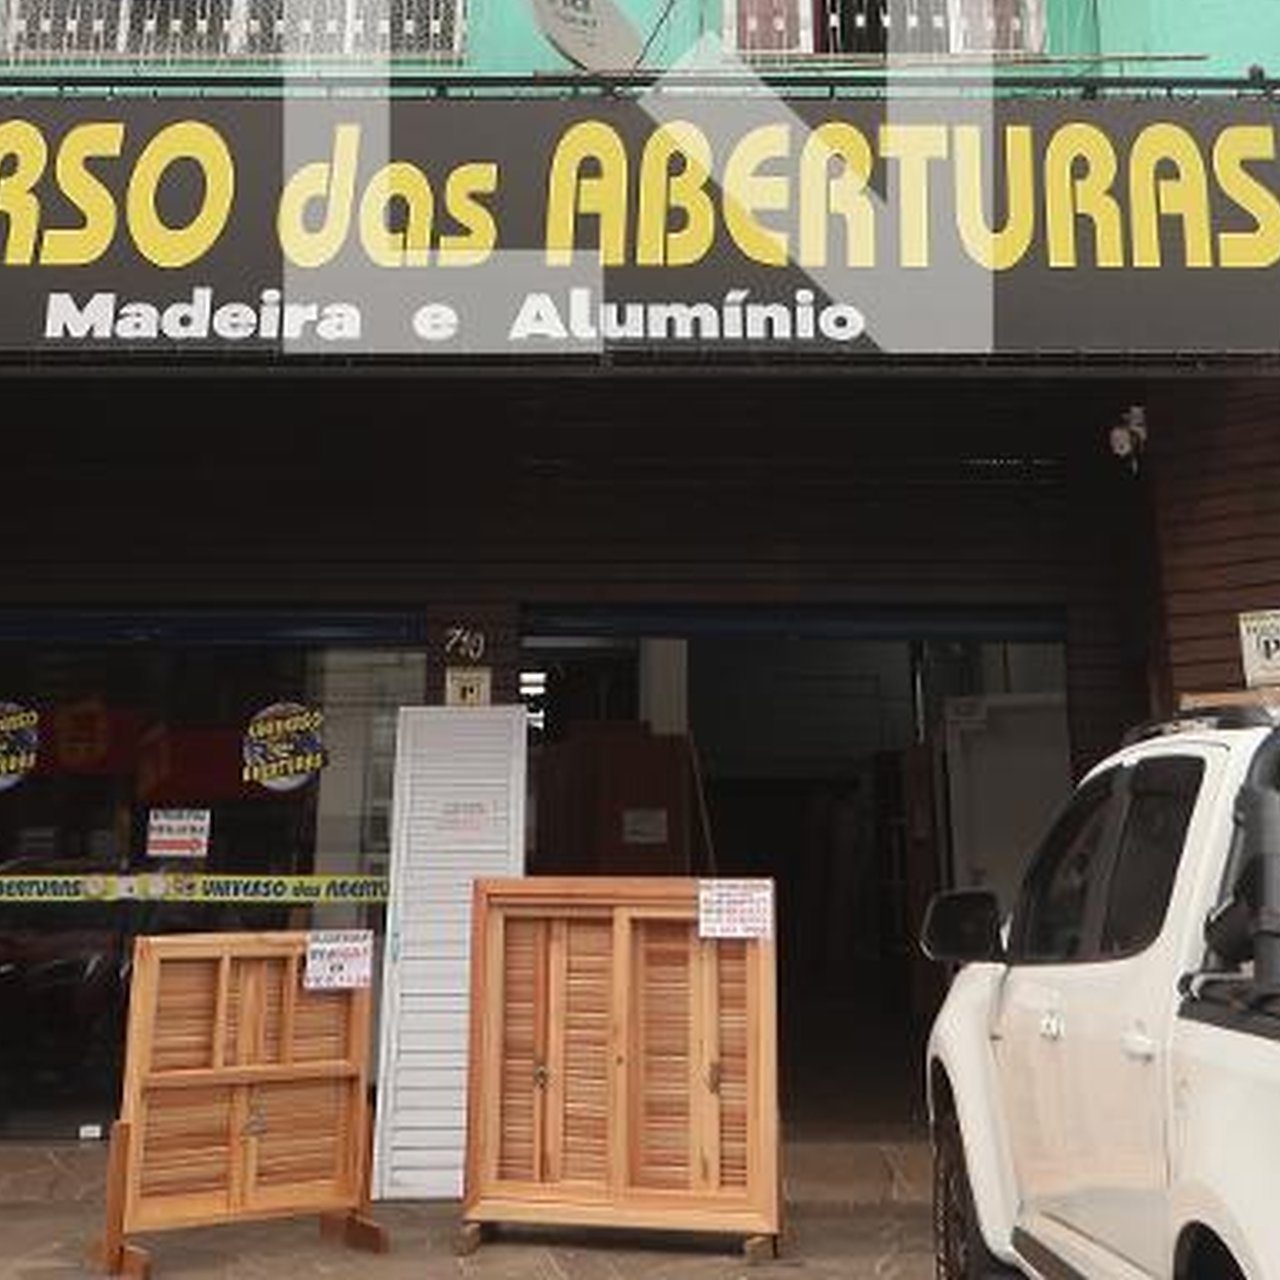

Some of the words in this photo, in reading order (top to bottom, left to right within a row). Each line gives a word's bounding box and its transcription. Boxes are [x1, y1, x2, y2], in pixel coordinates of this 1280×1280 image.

[277, 122, 498, 269] das
[44, 286, 363, 340] Madeira
[412, 302, 460, 341] e
[508, 286, 867, 341] Alumínio
